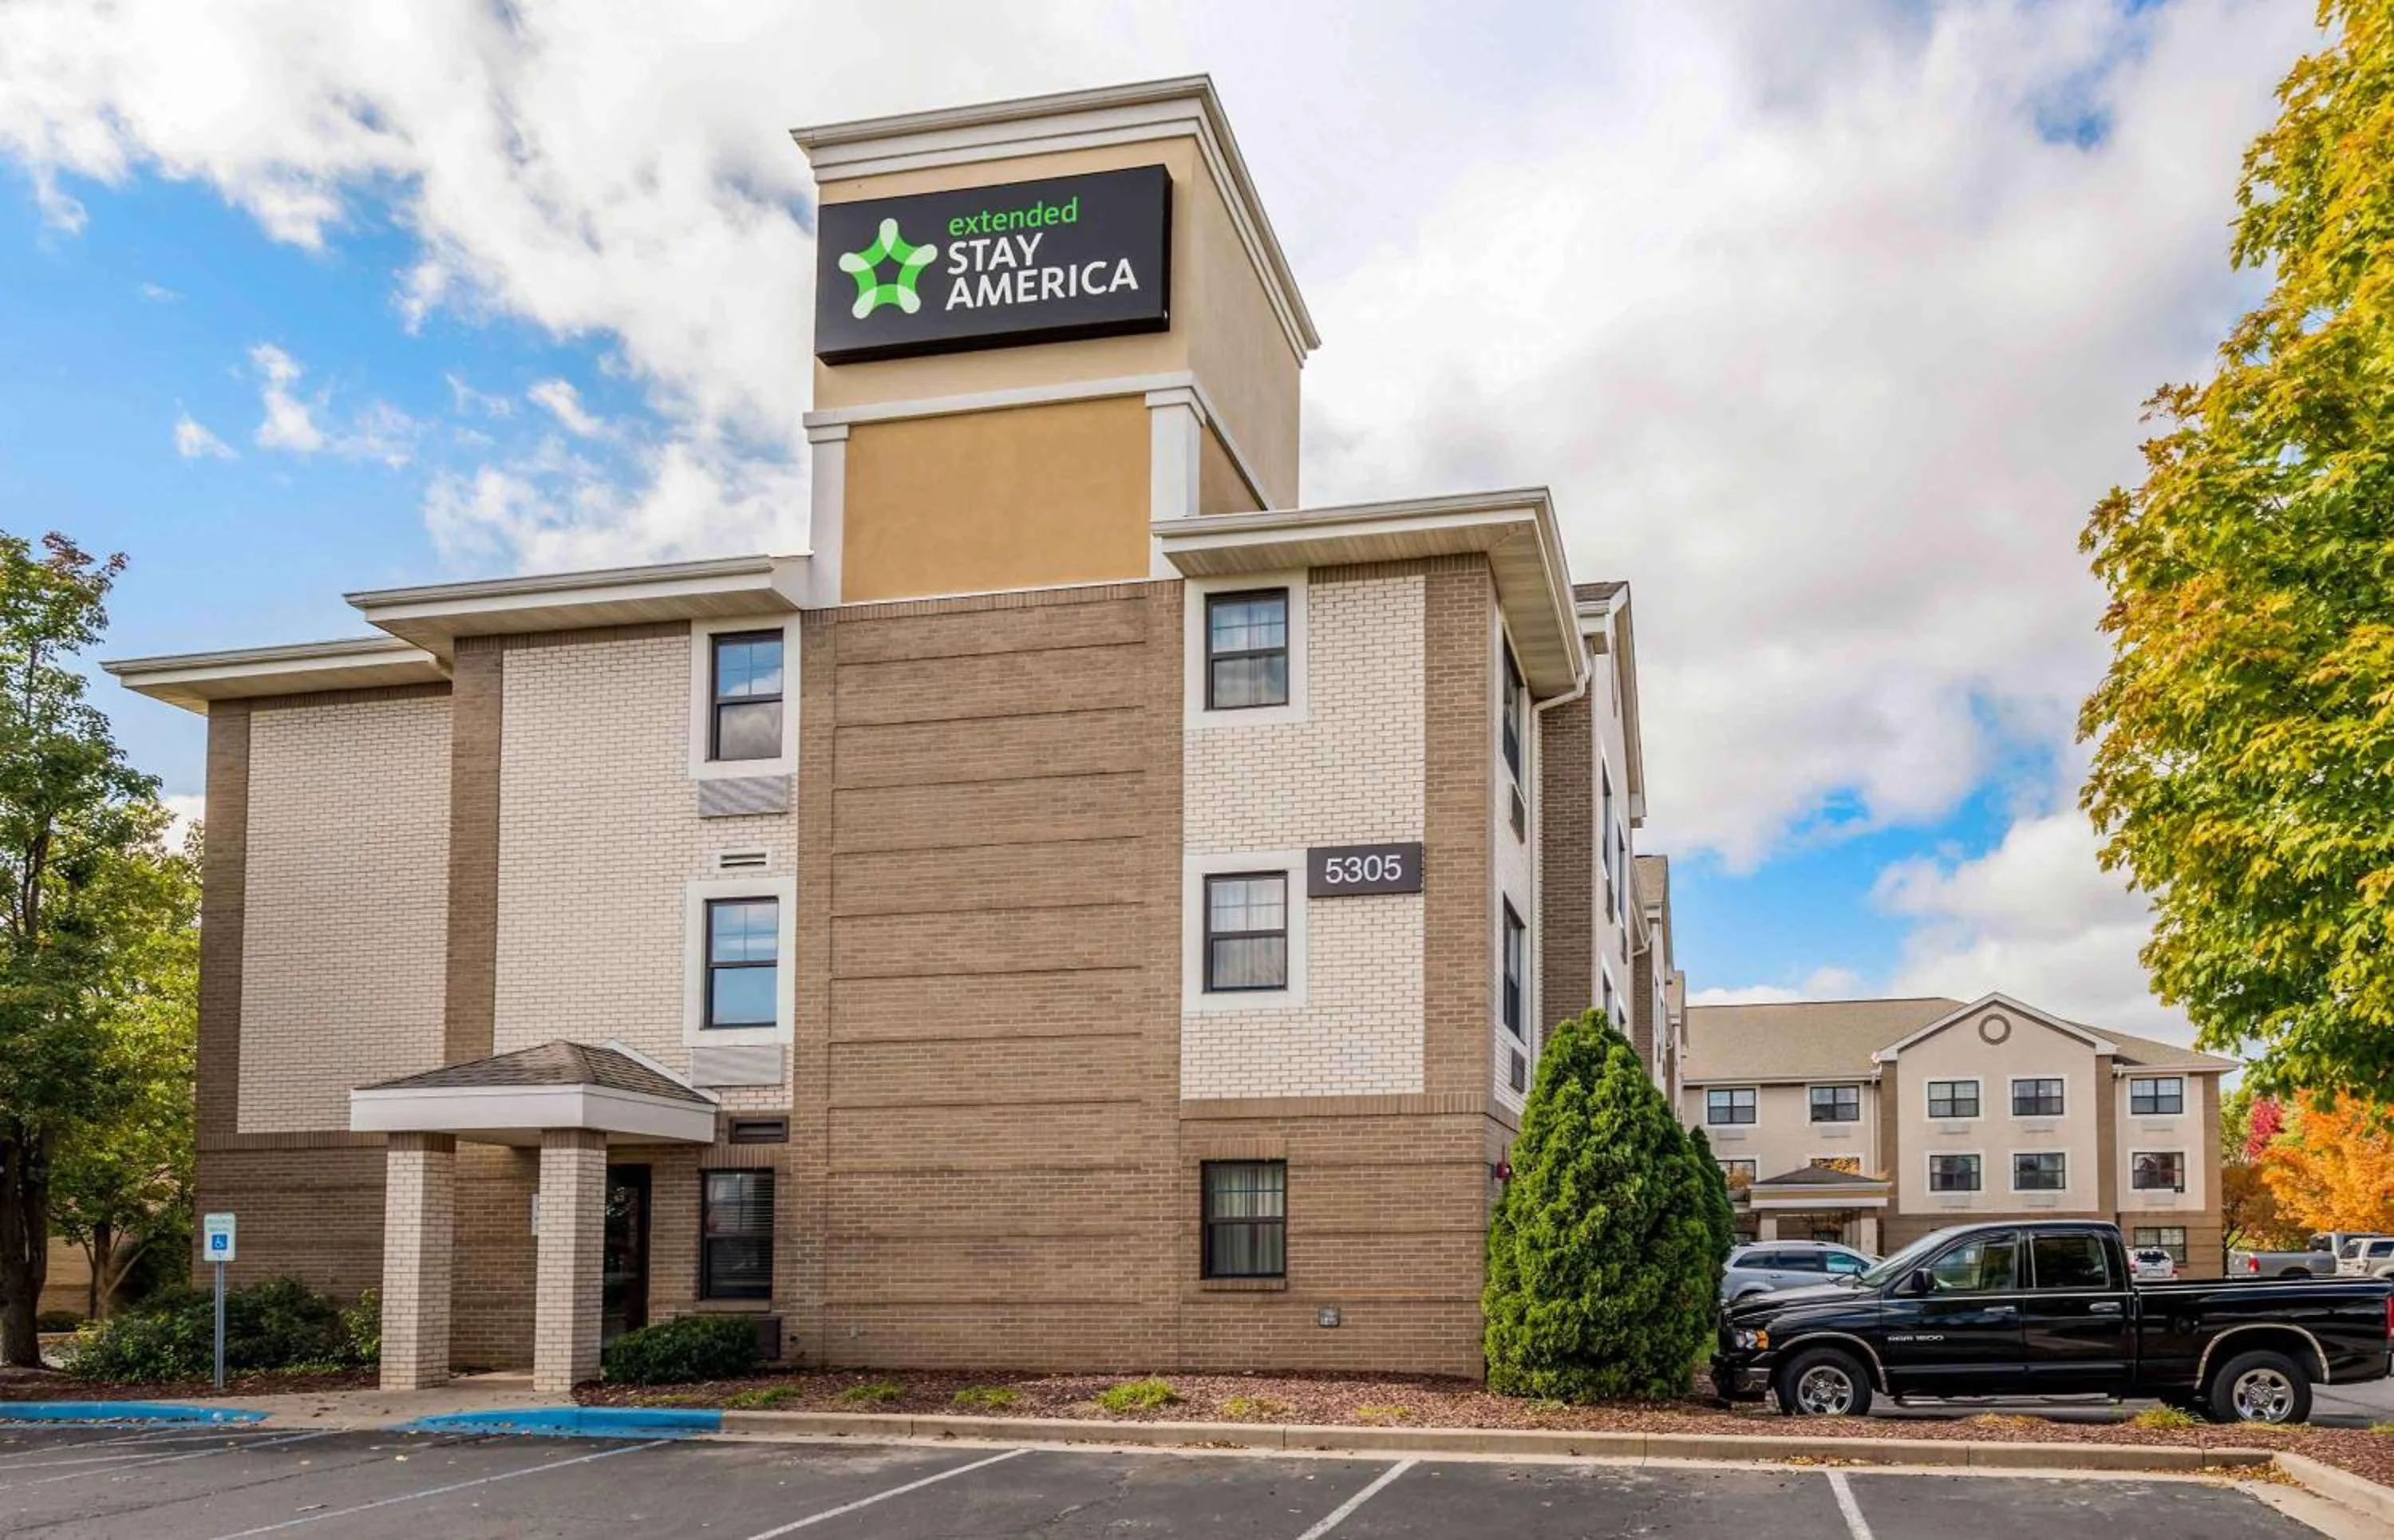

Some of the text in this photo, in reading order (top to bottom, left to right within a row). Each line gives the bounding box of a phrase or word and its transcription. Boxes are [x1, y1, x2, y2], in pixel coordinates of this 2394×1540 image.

[948, 197, 1077, 236] extended
[947, 233, 1044, 274] STAY
[945, 258, 1139, 311] AMERICA
[1325, 855, 1402, 884] 5305
